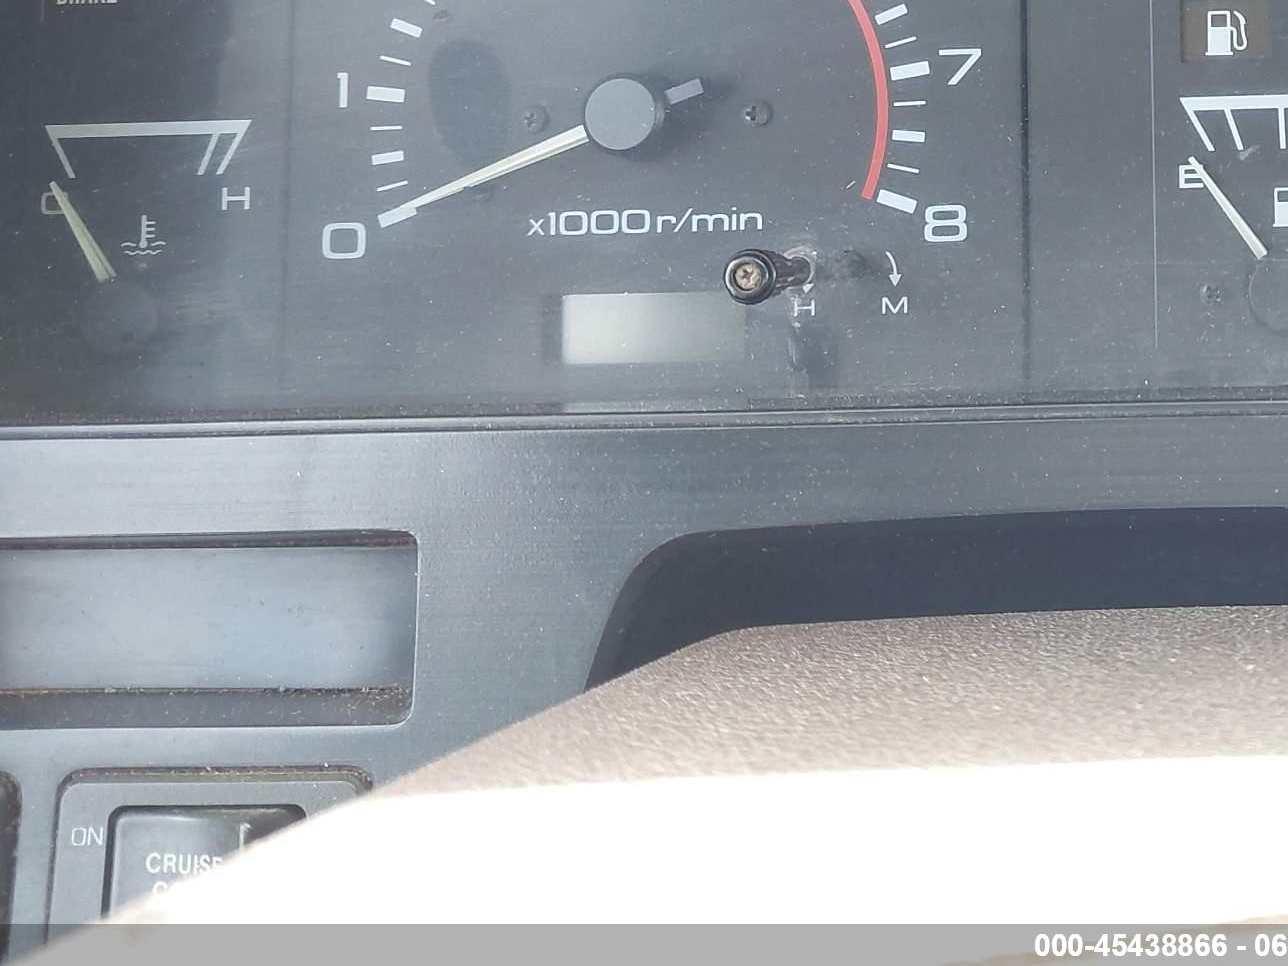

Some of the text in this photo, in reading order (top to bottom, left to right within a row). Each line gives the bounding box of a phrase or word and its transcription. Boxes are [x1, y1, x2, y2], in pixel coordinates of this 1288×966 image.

[939, 48, 982, 85] 7
[337, 73, 348, 108] 1
[1179, 165, 1204, 188] E
[222, 187, 250, 210] H
[924, 205, 968, 242] 8
[322, 222, 366, 259] 0
[794, 300, 816, 317] H
[882, 296, 908, 315] M
[71, 827, 104, 847] ON
